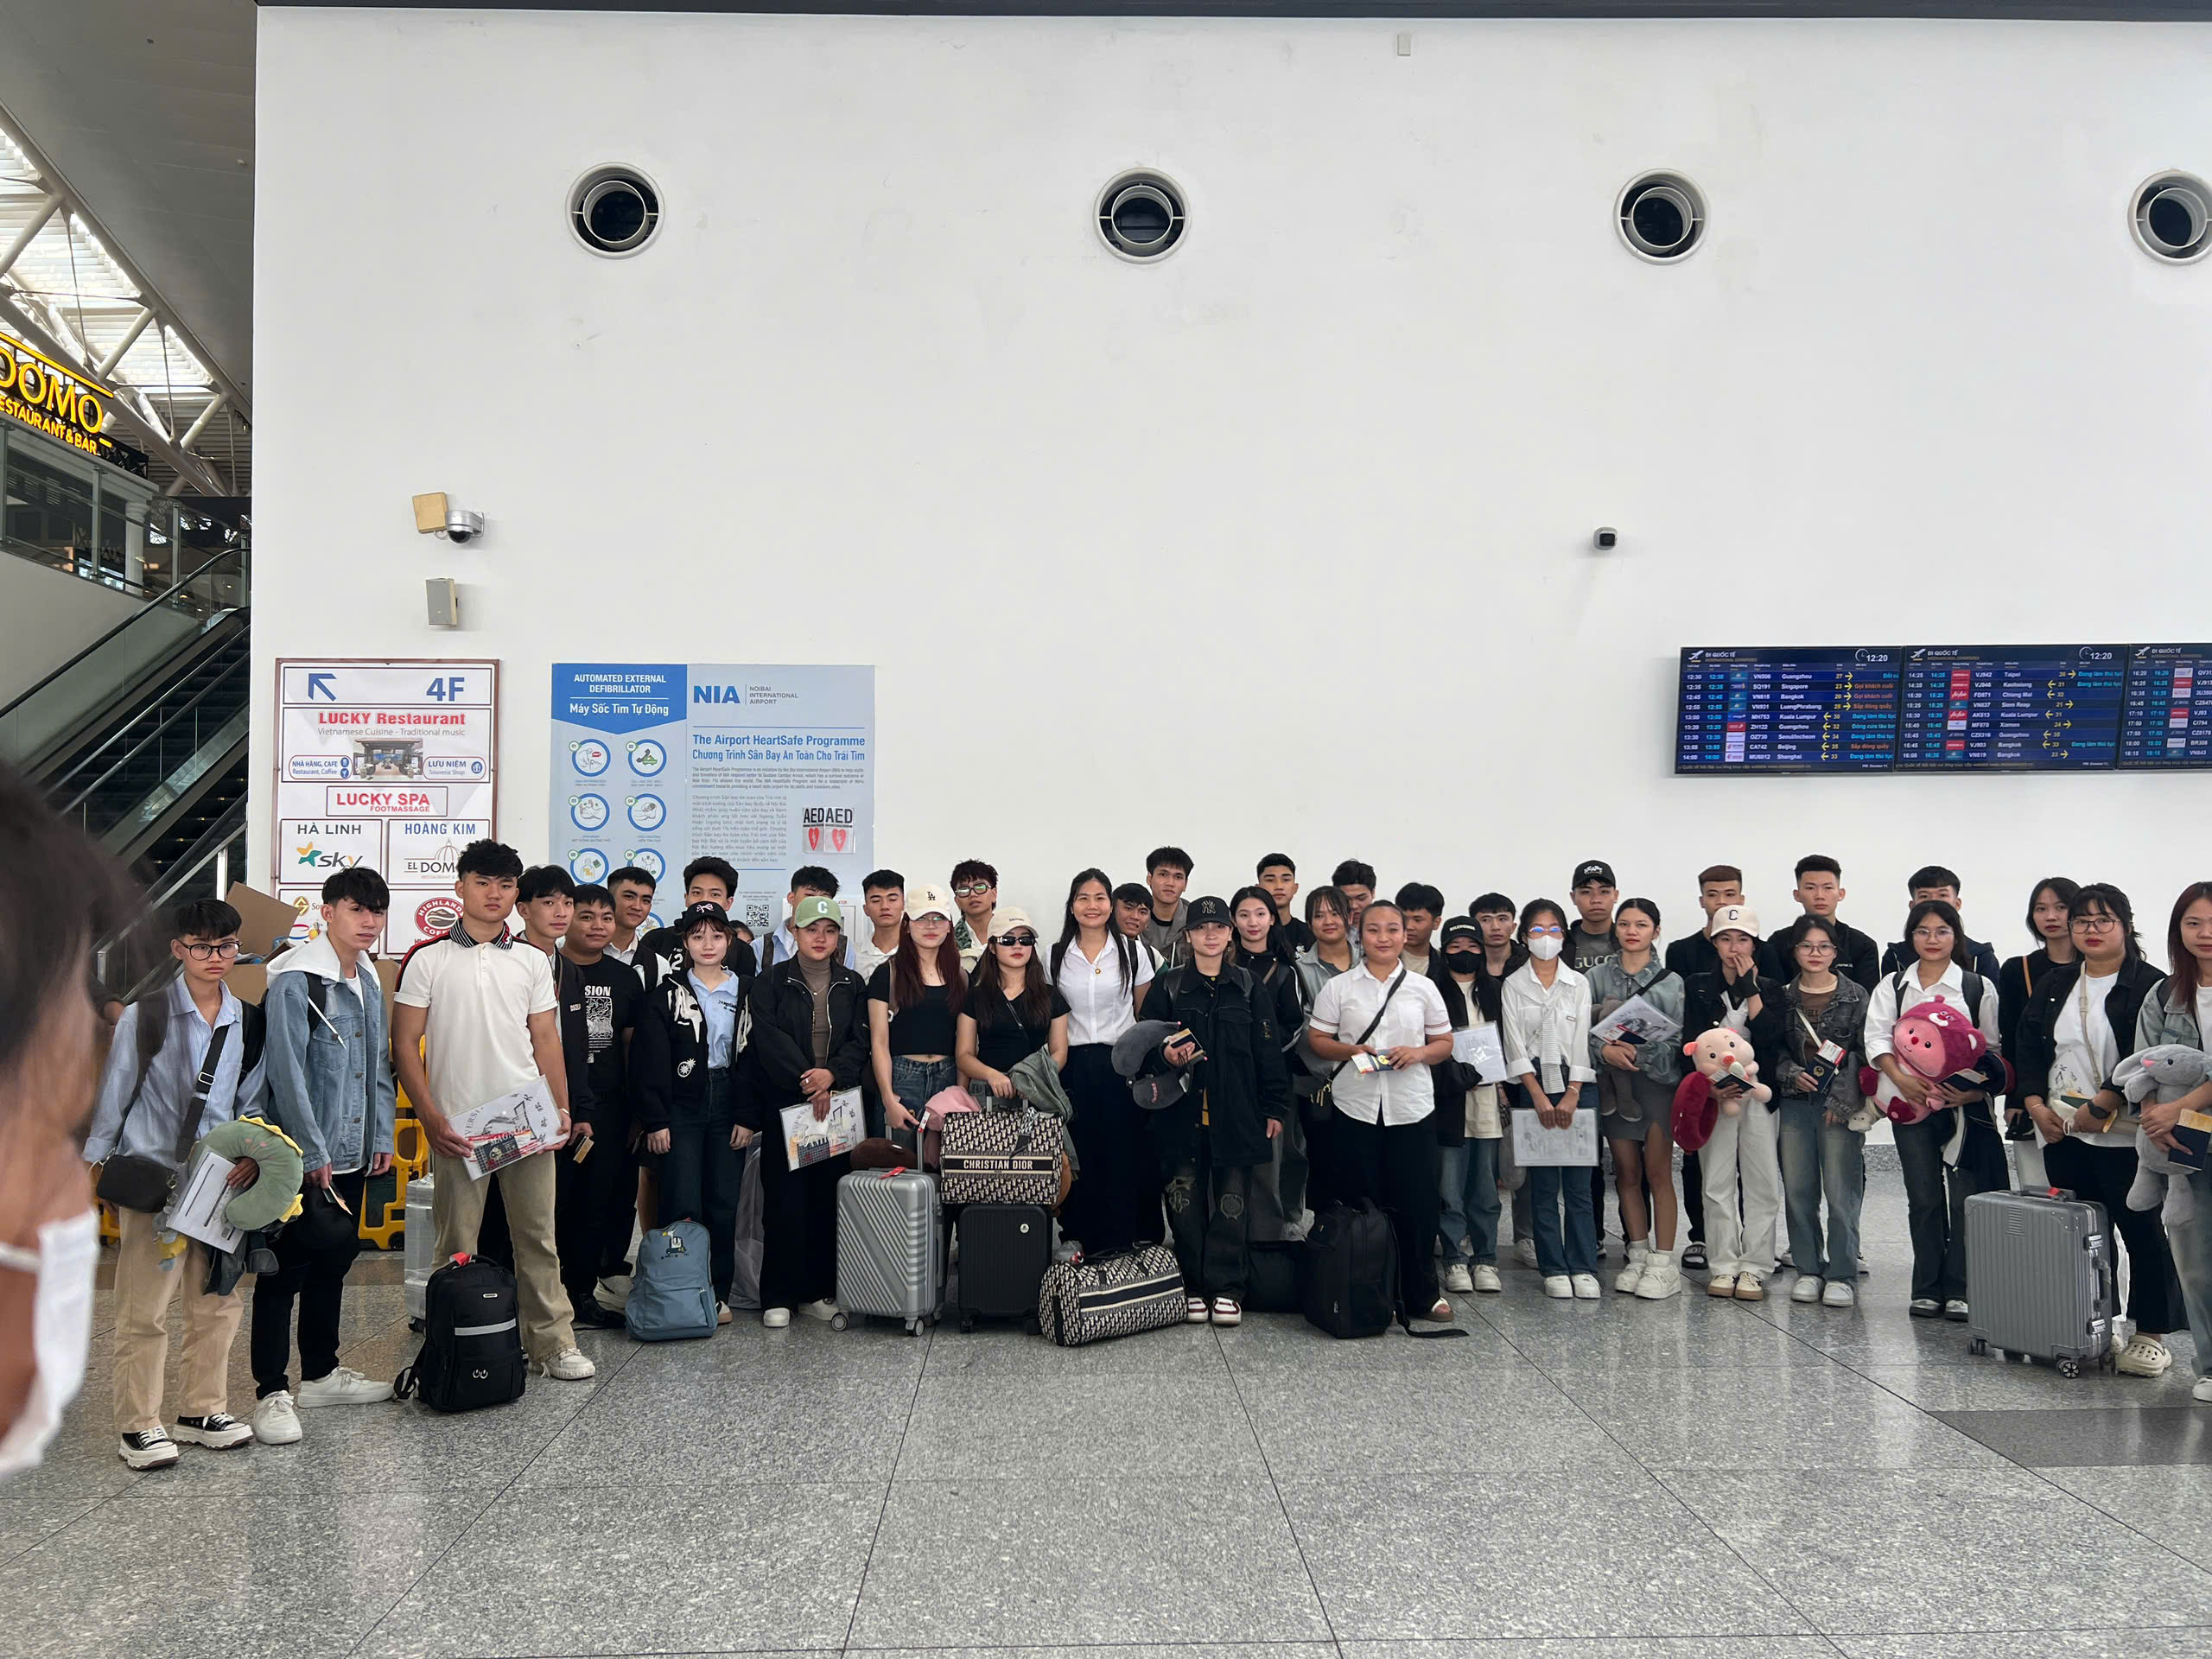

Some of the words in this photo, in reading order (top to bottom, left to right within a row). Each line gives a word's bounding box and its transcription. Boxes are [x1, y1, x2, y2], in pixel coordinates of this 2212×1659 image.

[574, 674, 623, 683] AUTOMATED
[625, 674, 667, 683] EXTERNAL
[426, 677, 465, 702] 4F
[589, 684, 651, 693] DEFIBRILLATOR
[693, 685, 741, 703] NIA
[569, 702, 589, 716] Máy
[592, 702, 609, 714] Sốc
[612, 703, 629, 714] Tim
[631, 703, 644, 715] Tự
[645, 703, 669, 716] Động
[319, 712, 371, 724] LUCKY
[377, 713, 466, 725] Restaurant
[692, 734, 711, 745] The
[715, 734, 750, 747] Airport
[753, 734, 803, 746] HeartSafe
[806, 735, 865, 748] Programme
[748, 749, 763, 760] Sân
[766, 750, 781, 762] Bay
[783, 750, 793, 760] An
[817, 750, 831, 760] Cho
[834, 750, 849, 760] Trái
[851, 751, 865, 760] Tim
[336, 793, 392, 805] LUCKY
[397, 793, 430, 805] SPA
[804, 808, 824, 823] AED
[825, 808, 853, 823] AED
[297, 822, 320, 835] HÀ
[325, 824, 361, 835] LINH
[404, 821, 447, 835] HOÀNG
[453, 823, 475, 835] KIM
[408, 861, 418, 870] EL
[421, 861, 457, 873] DOM
[817, 900, 828, 914] C
[1201, 899, 1217, 914] NY
[1728, 909, 1738, 921] C
[1574, 954, 1618, 969] GUCC
[963, 1160, 1009, 1170] CHRISTIAN
[1012, 1160, 1033, 1170] DIOR
